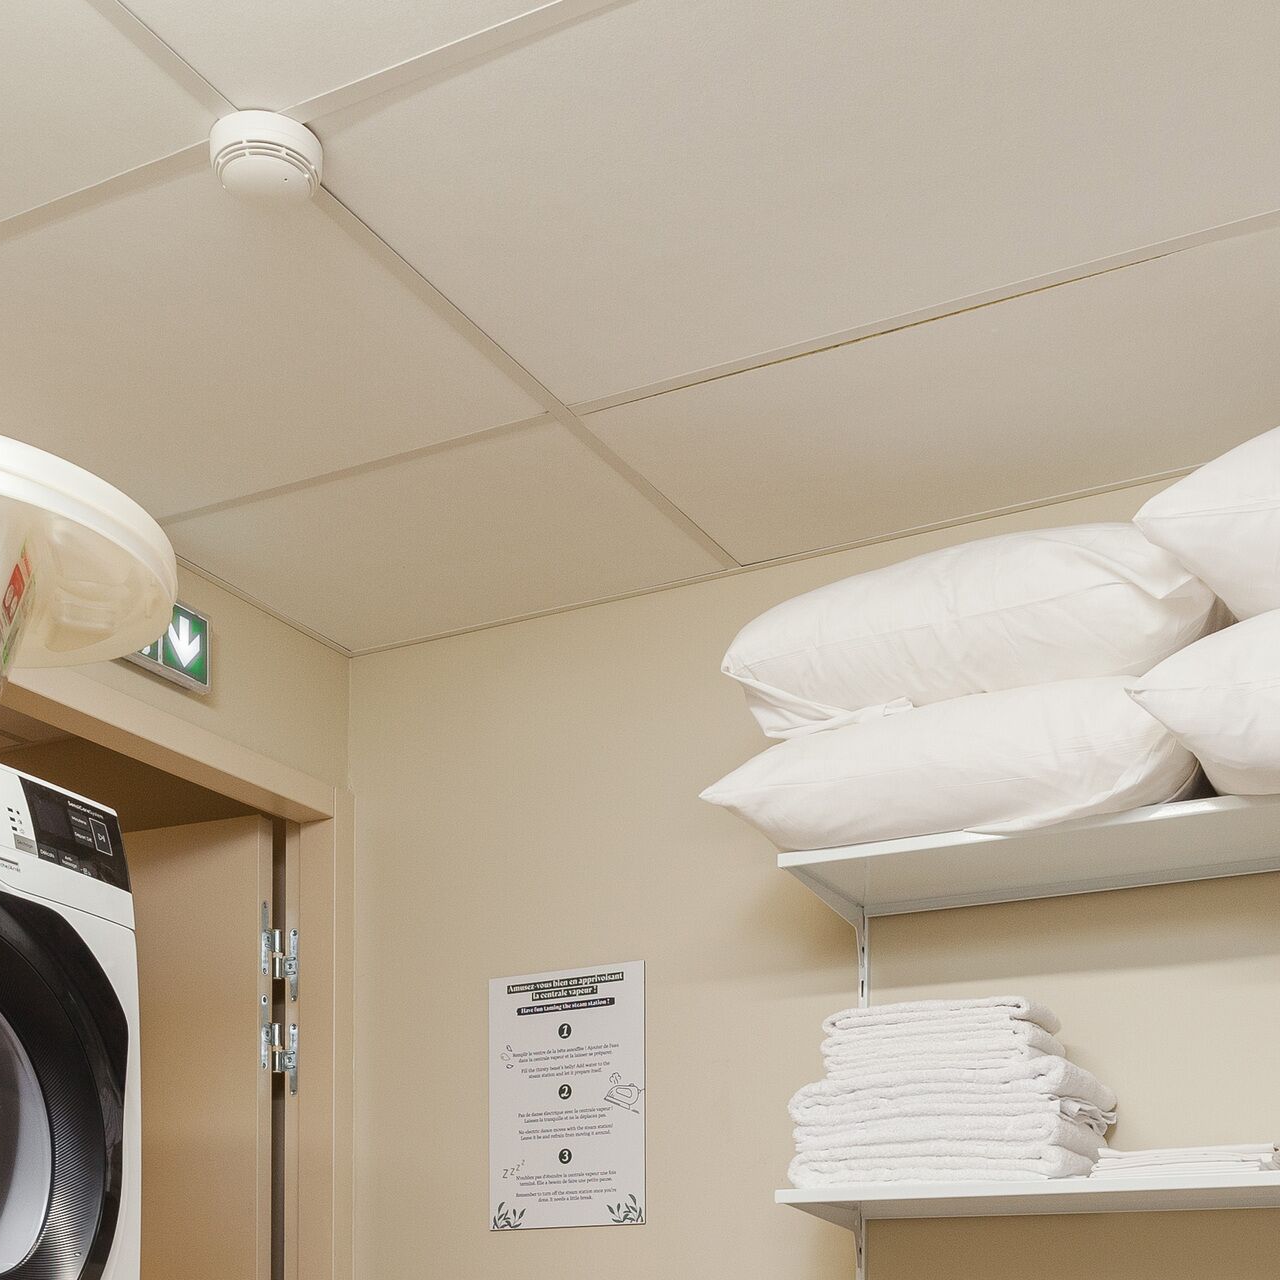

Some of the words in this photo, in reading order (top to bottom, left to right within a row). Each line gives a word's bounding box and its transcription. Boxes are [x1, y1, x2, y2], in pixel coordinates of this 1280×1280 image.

[553, 979, 567, 987] bien
[568, 978, 577, 986] en
[533, 992, 539, 1000] la
[561, 1025, 568, 1037] 1
[562, 1150, 569, 1162] 3
